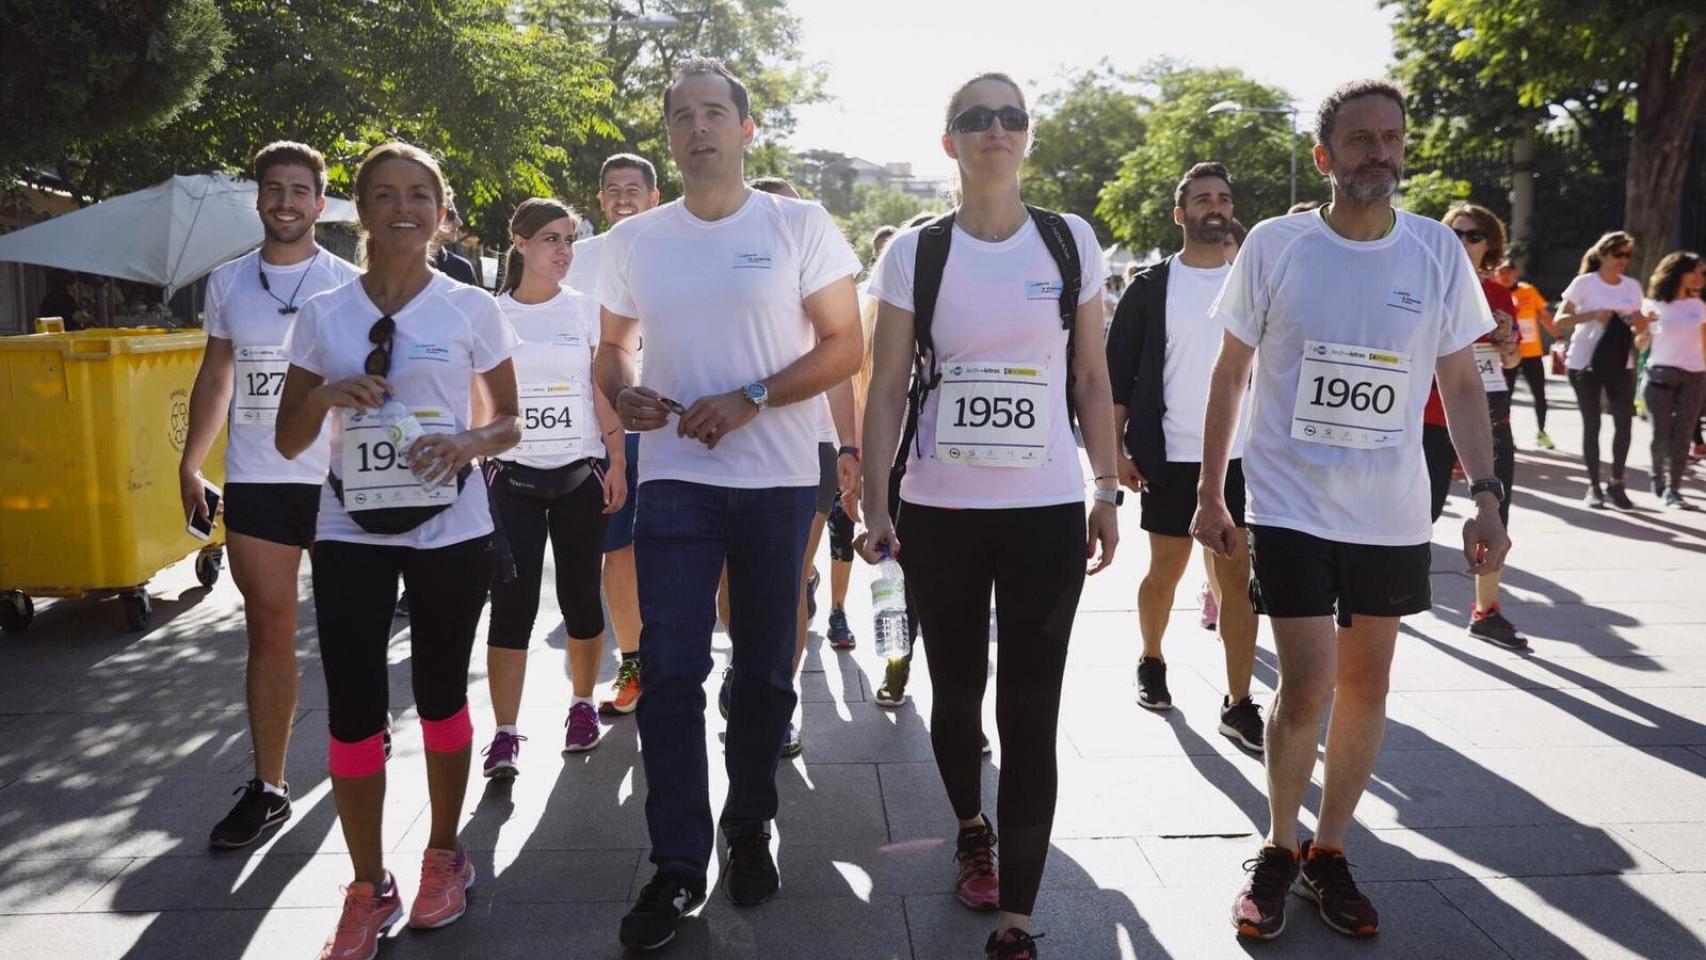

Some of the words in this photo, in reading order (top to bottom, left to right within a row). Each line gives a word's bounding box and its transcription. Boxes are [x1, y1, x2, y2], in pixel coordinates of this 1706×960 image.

[1310, 376, 1395, 414] 1960
[523, 406, 572, 430] 564
[953, 396, 1035, 429] 1958
